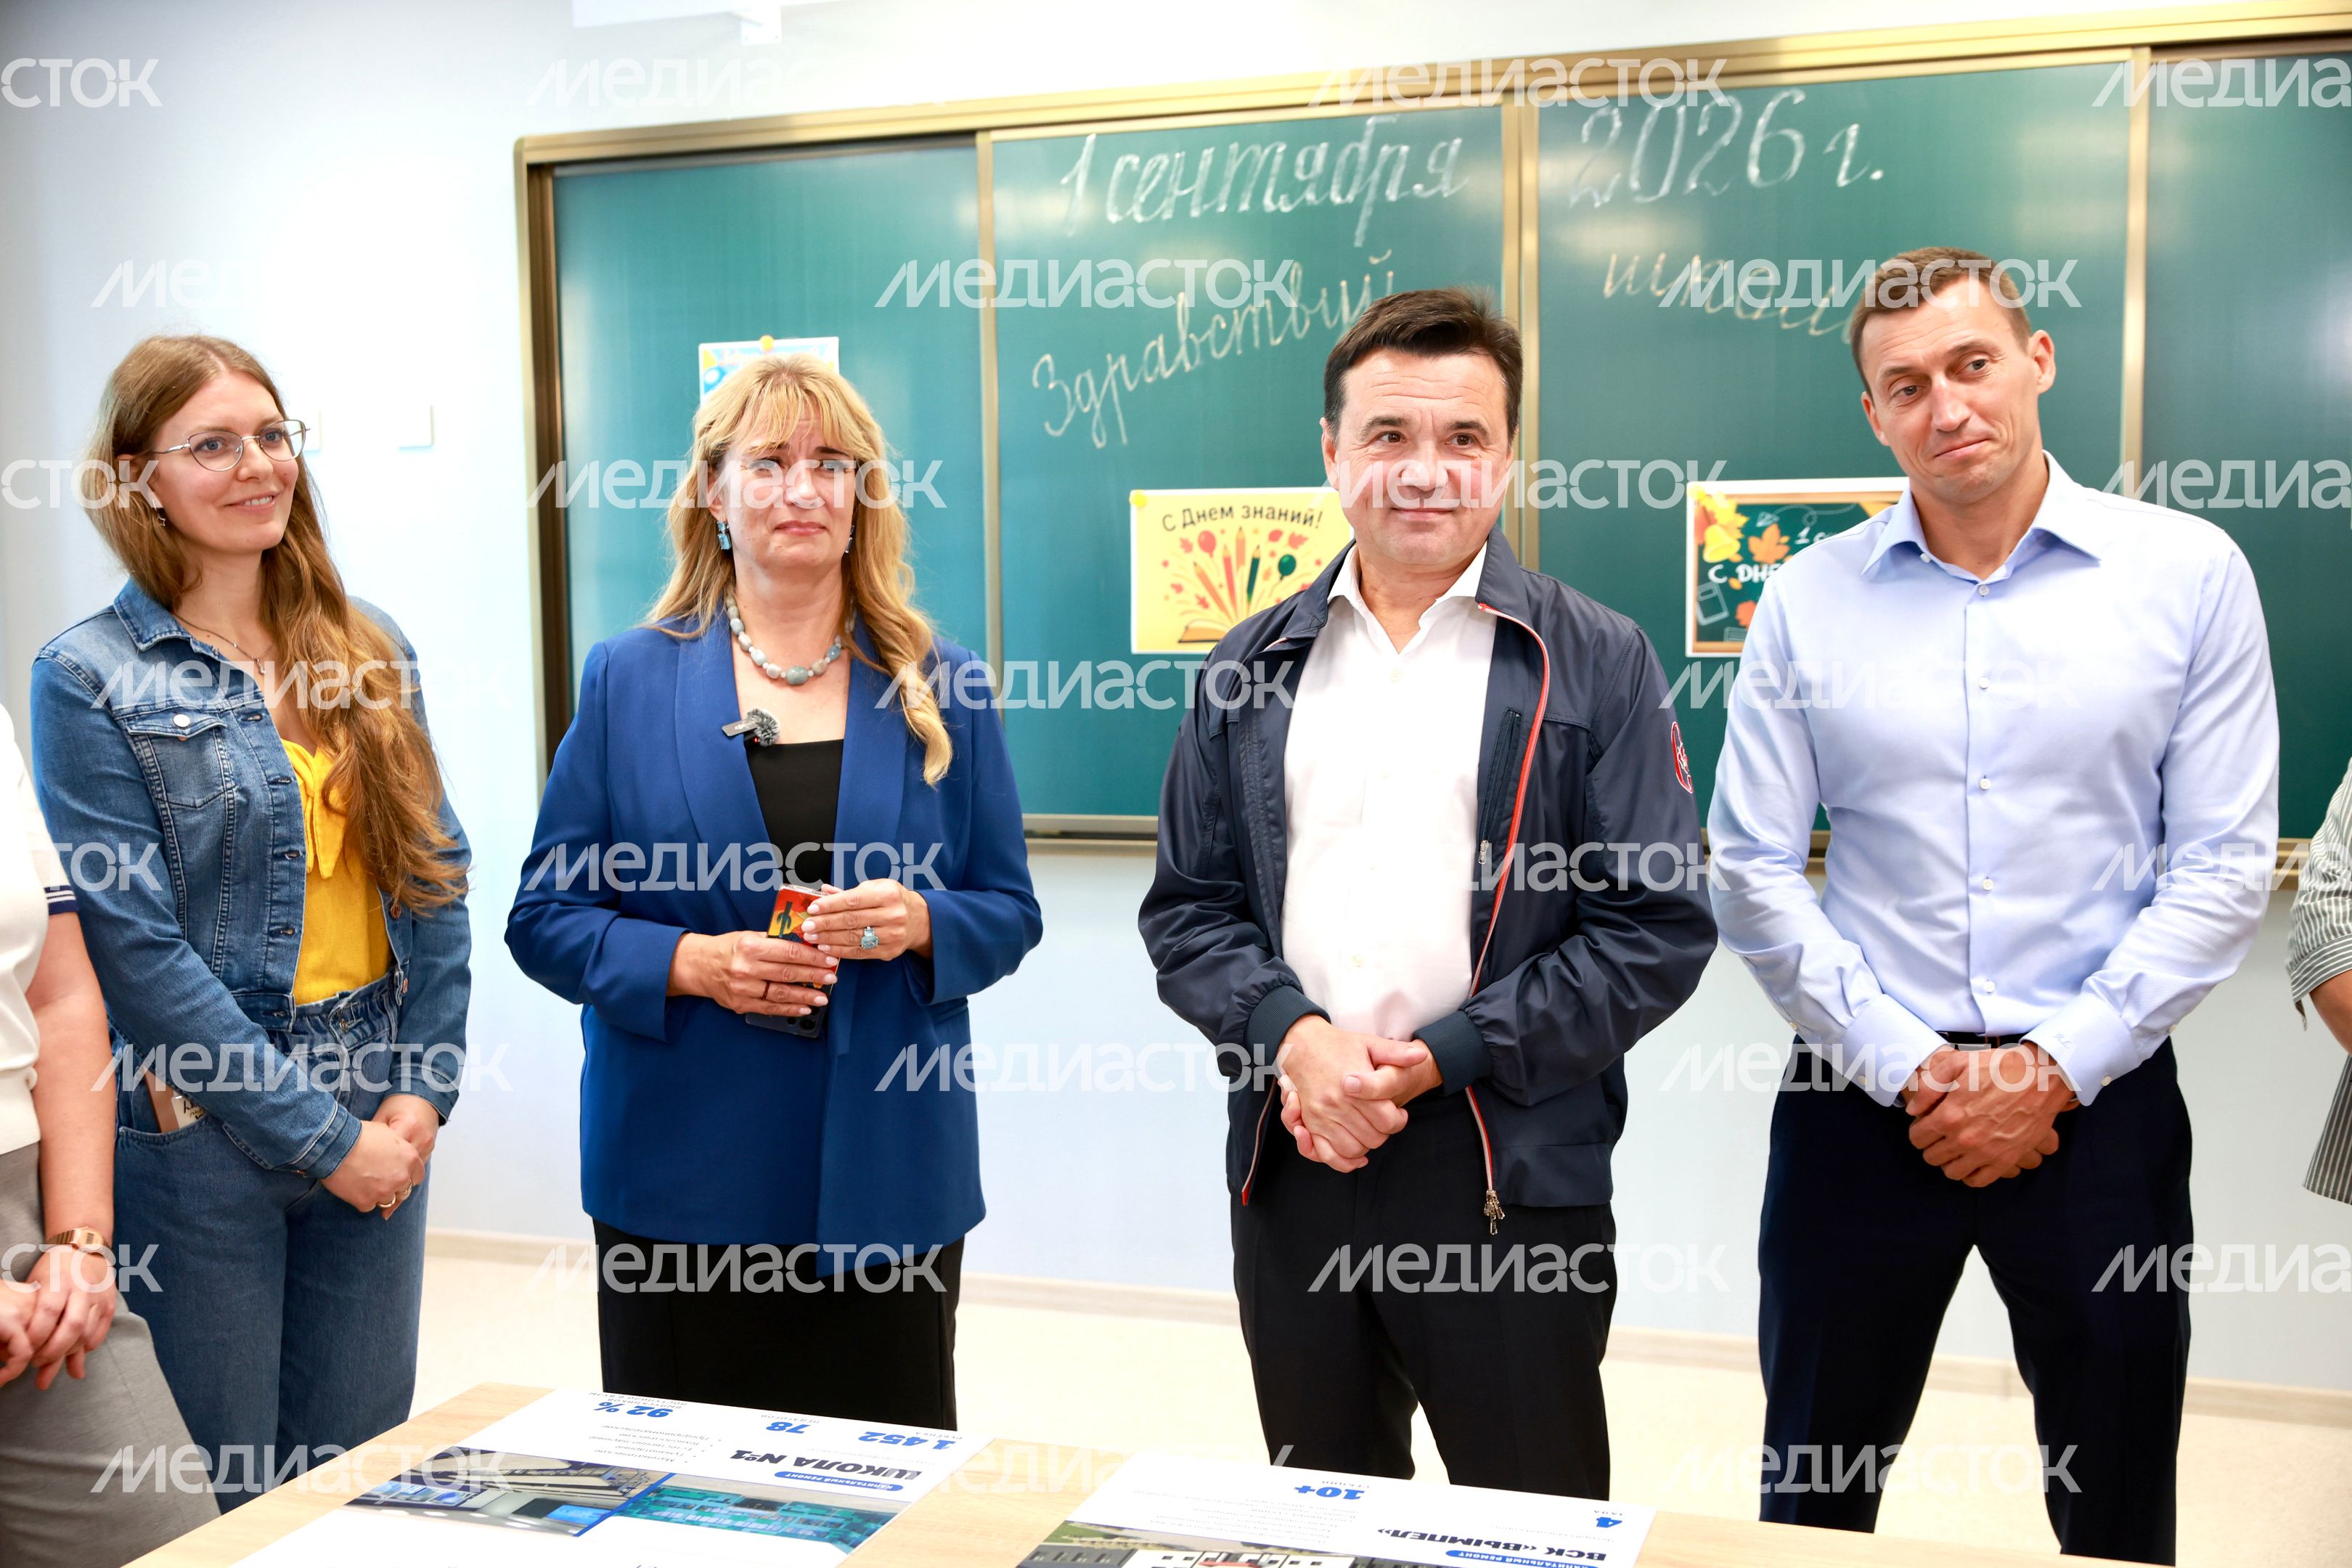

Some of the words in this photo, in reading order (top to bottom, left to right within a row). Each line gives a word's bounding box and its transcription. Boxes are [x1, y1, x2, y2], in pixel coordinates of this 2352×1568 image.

[1061, 133, 1096, 238] 1
[1106, 114, 1470, 248] сентября
[1569, 88, 1805, 209] 2026
[1822, 123, 1884, 188] г.
[1162, 514, 1176, 532] С
[1182, 505, 1234, 528] Днем
[1241, 504, 1323, 528] знаний!
[765, 1421, 811, 1434] 78
[730, 1450, 787, 1464] №1
[793, 1457, 922, 1480] ШКОЛА
[785, 1473, 824, 1483] РЕМОНТ
[824, 1477, 894, 1490] КАПИТАЛЬНЫЙ
[1294, 1485, 1365, 1500] 10+
[1596, 1516, 1622, 1529] 4
[1377, 1529, 1538, 1552] «ВЫМПЕЛ»
[1458, 1551, 1503, 1562] РЕМОНТ
[1545, 1547, 1607, 1561] ВСК
